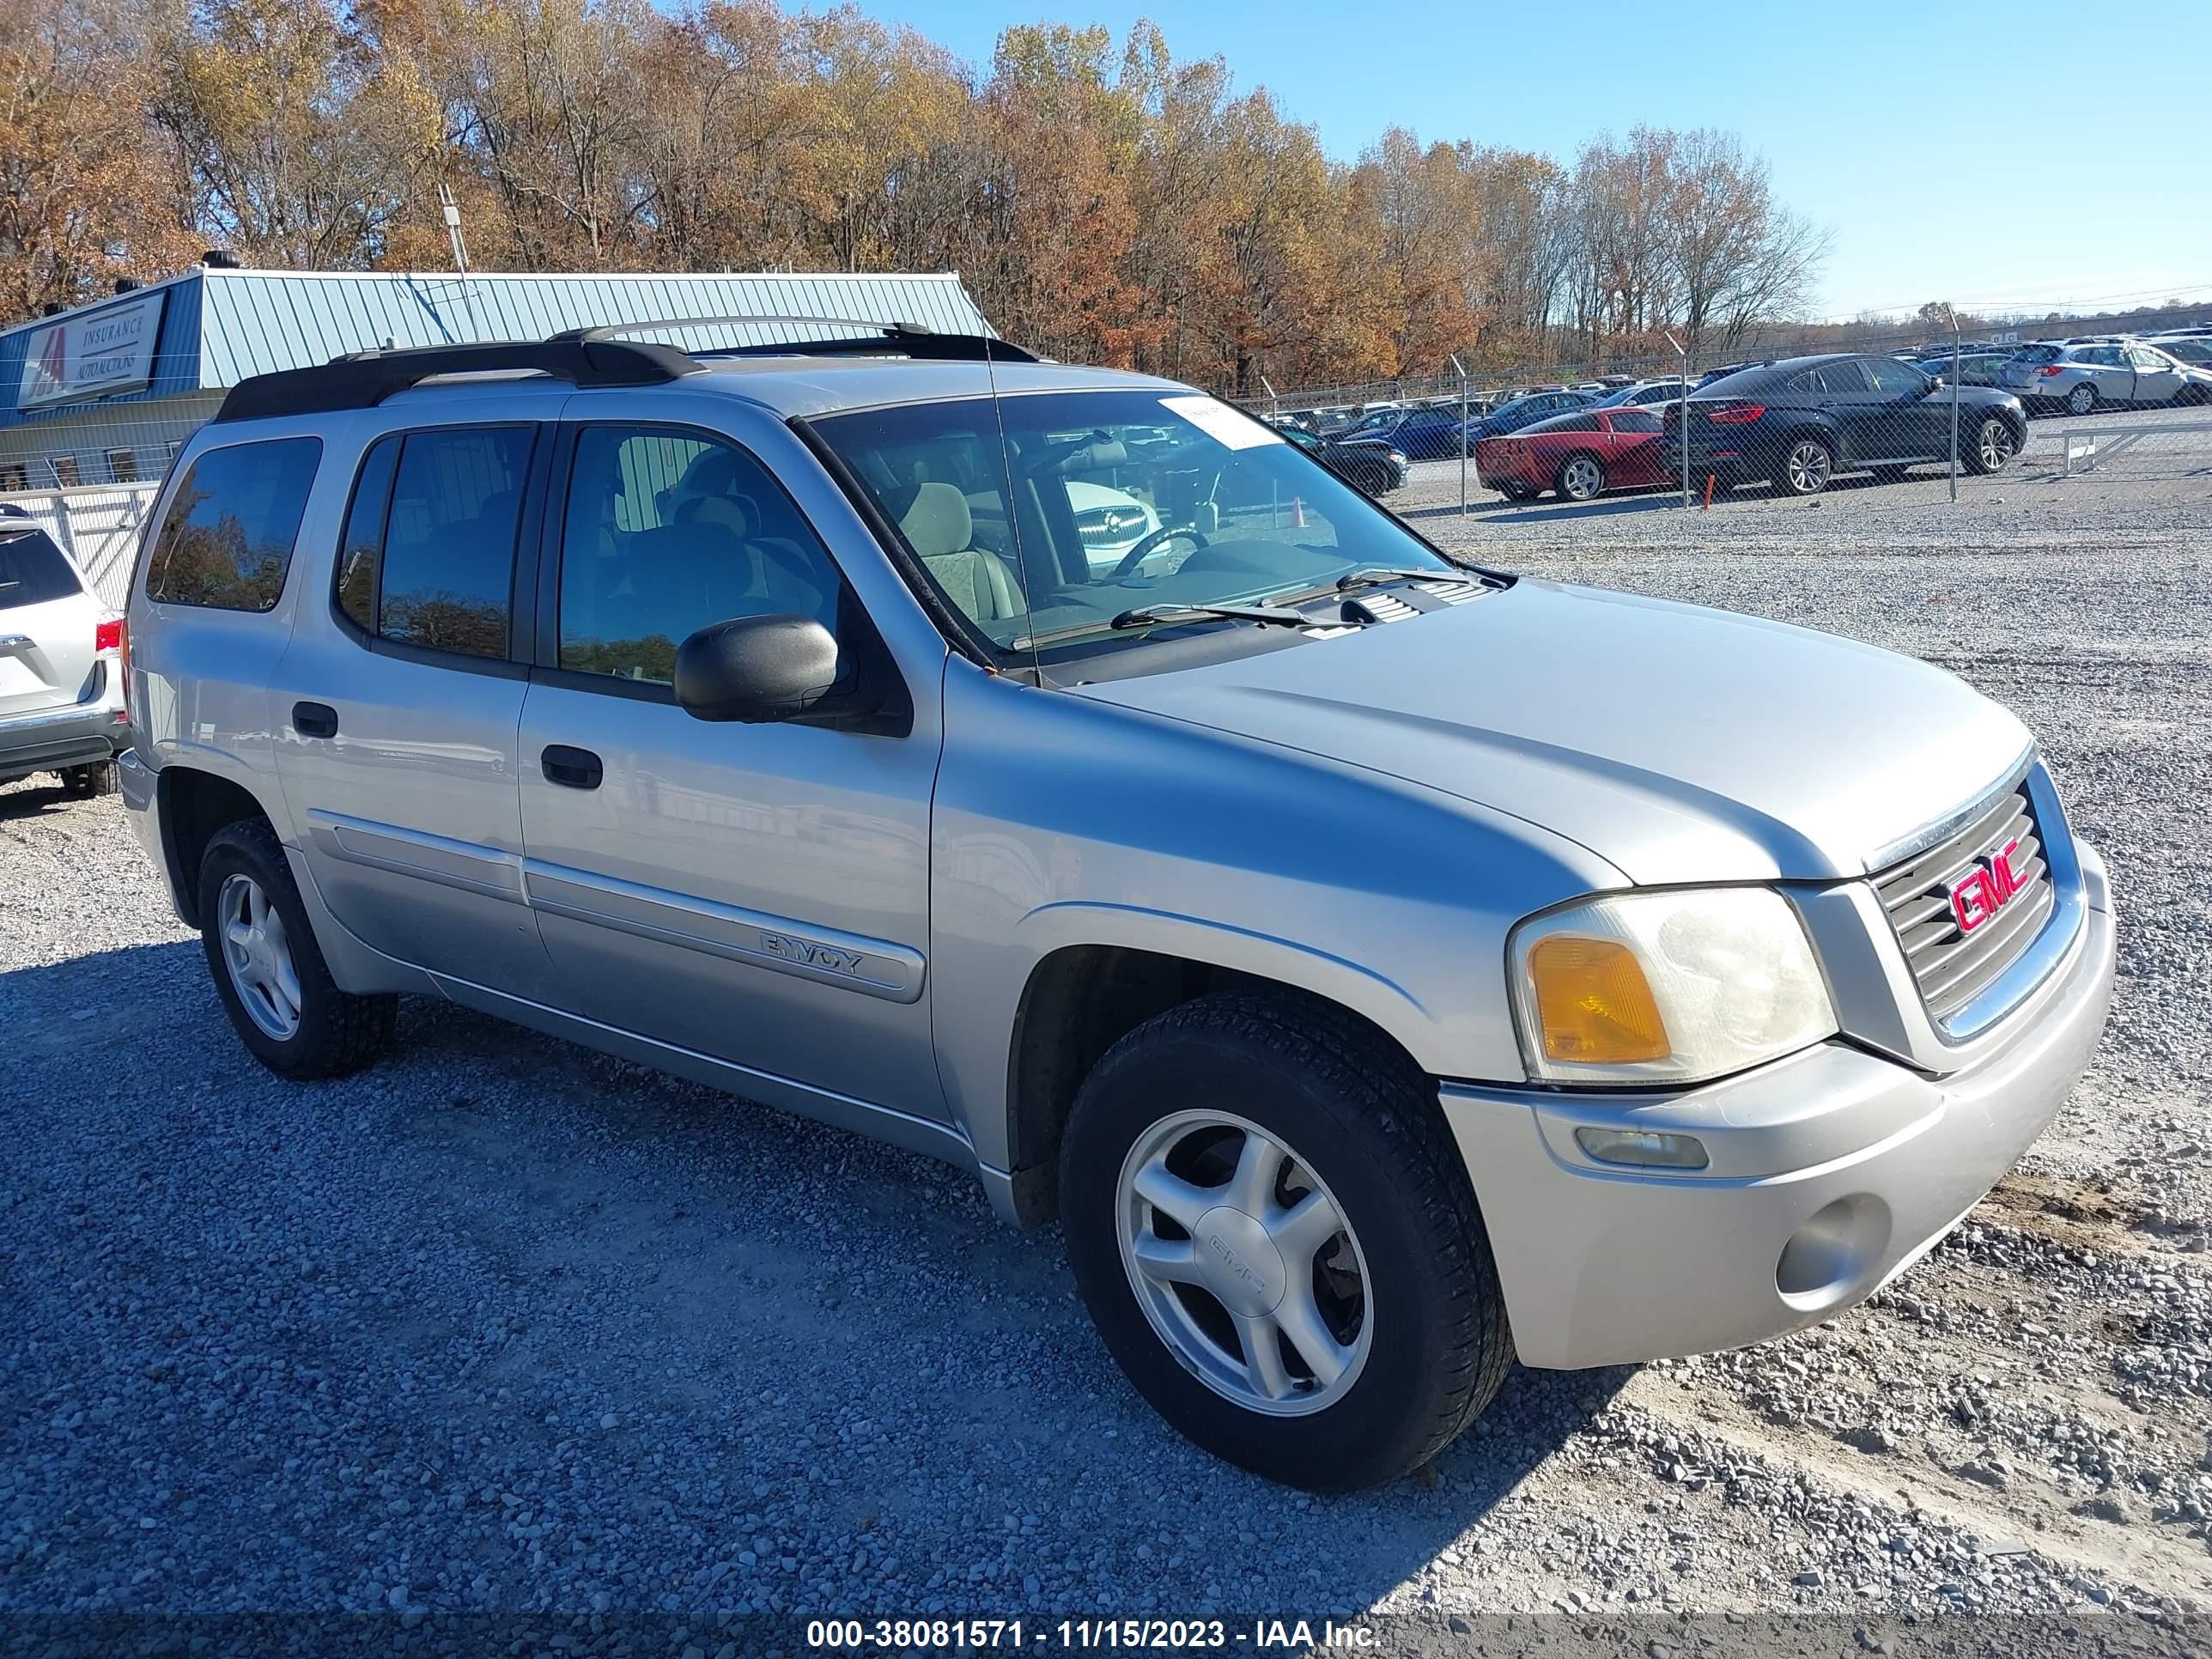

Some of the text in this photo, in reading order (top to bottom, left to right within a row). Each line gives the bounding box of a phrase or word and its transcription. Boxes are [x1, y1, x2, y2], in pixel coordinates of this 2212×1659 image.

[82, 316, 143, 348] INSURANCE
[76, 352, 137, 380] AUTO AUCTIONS
[1949, 836, 2028, 934] GMC
[760, 932, 863, 974] ENVOY
[1208, 1234, 1266, 1295] GMC
